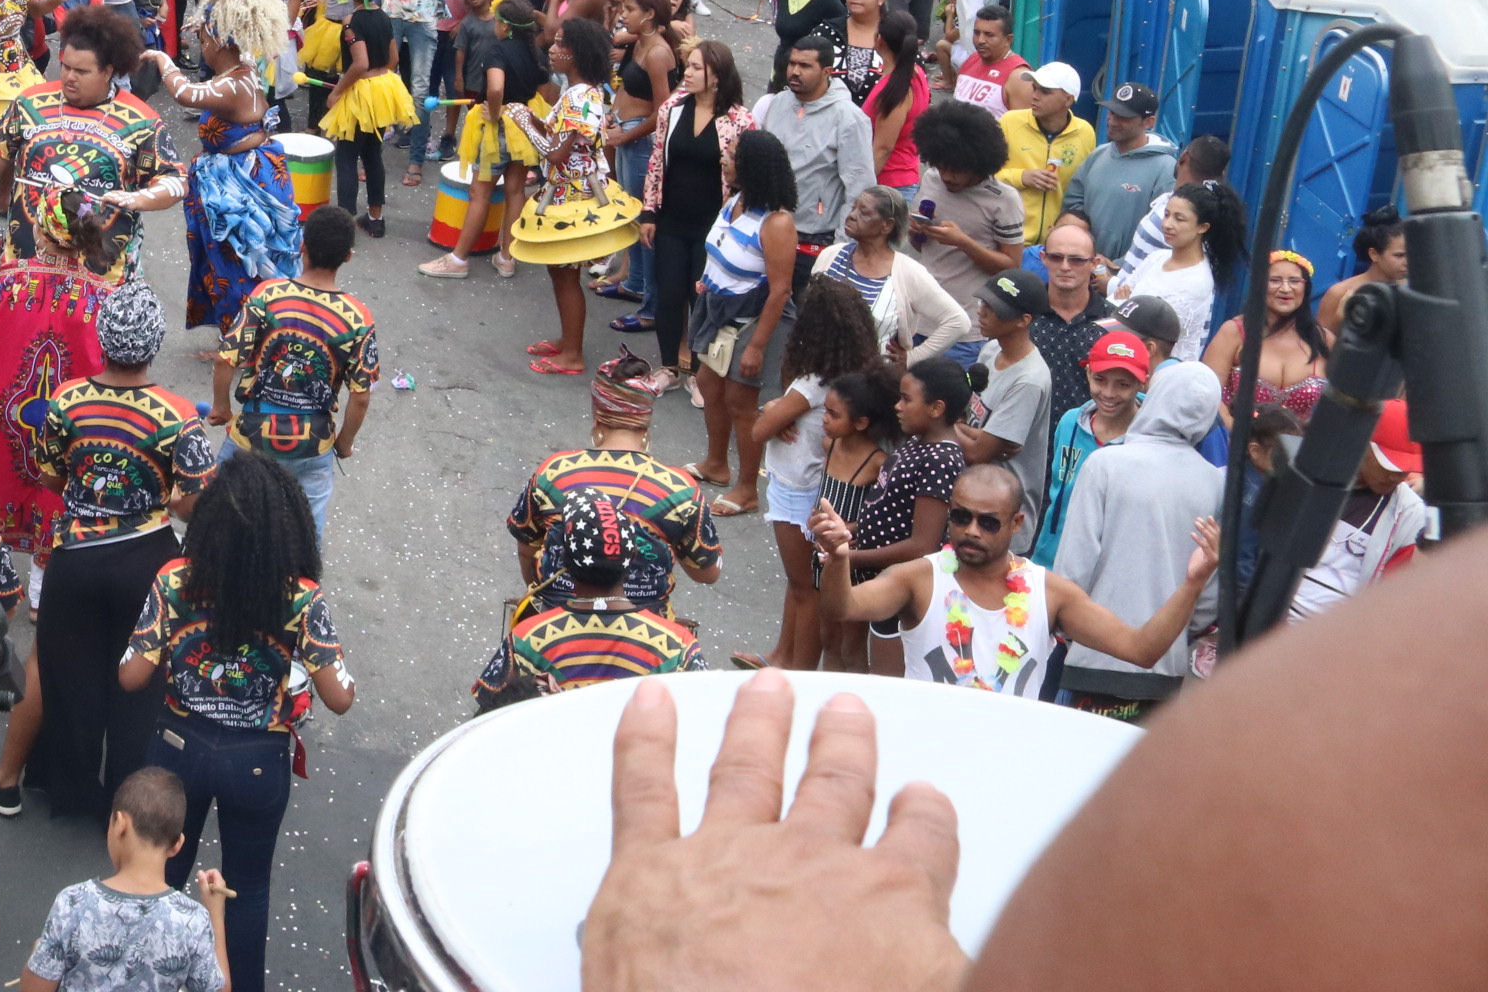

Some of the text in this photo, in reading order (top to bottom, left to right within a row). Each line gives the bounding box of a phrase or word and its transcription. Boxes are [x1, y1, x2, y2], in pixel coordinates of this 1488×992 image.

[31, 143, 115, 181] BLOCO AFRO
[106, 481, 124, 489] QUE
[594, 499, 621, 556] KINGS
